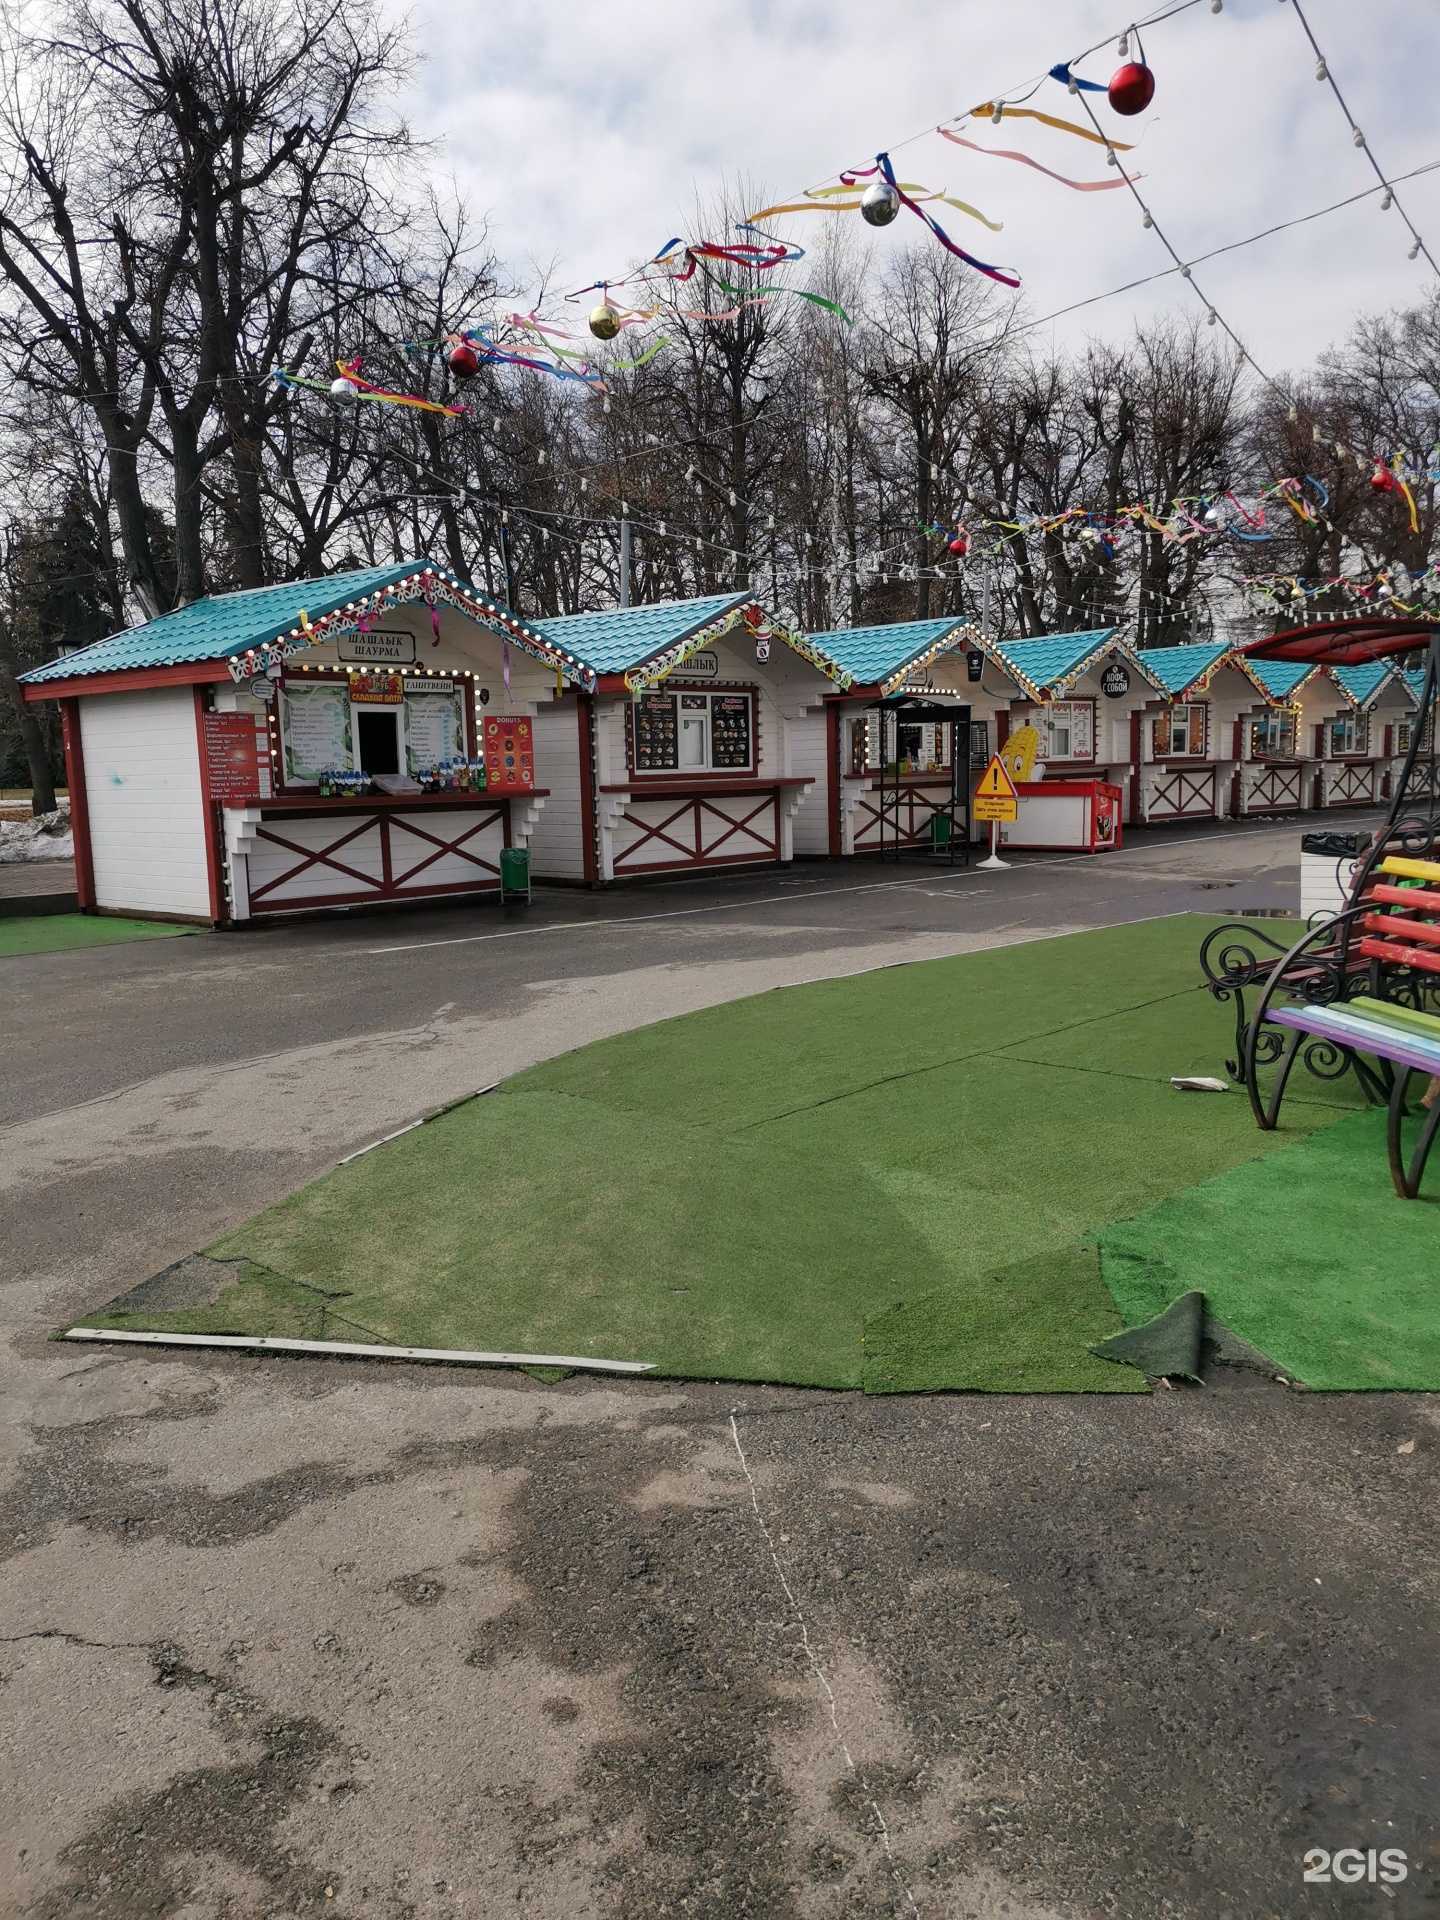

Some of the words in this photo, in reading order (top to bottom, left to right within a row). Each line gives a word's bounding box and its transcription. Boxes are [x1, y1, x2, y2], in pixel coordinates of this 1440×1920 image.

[348, 633, 403, 646] ШАШЛЫК
[354, 645, 400, 657] ШАУРМА
[1106, 671, 1125, 682] КОФЕ
[1108, 680, 1128, 692] СОБОЙ
